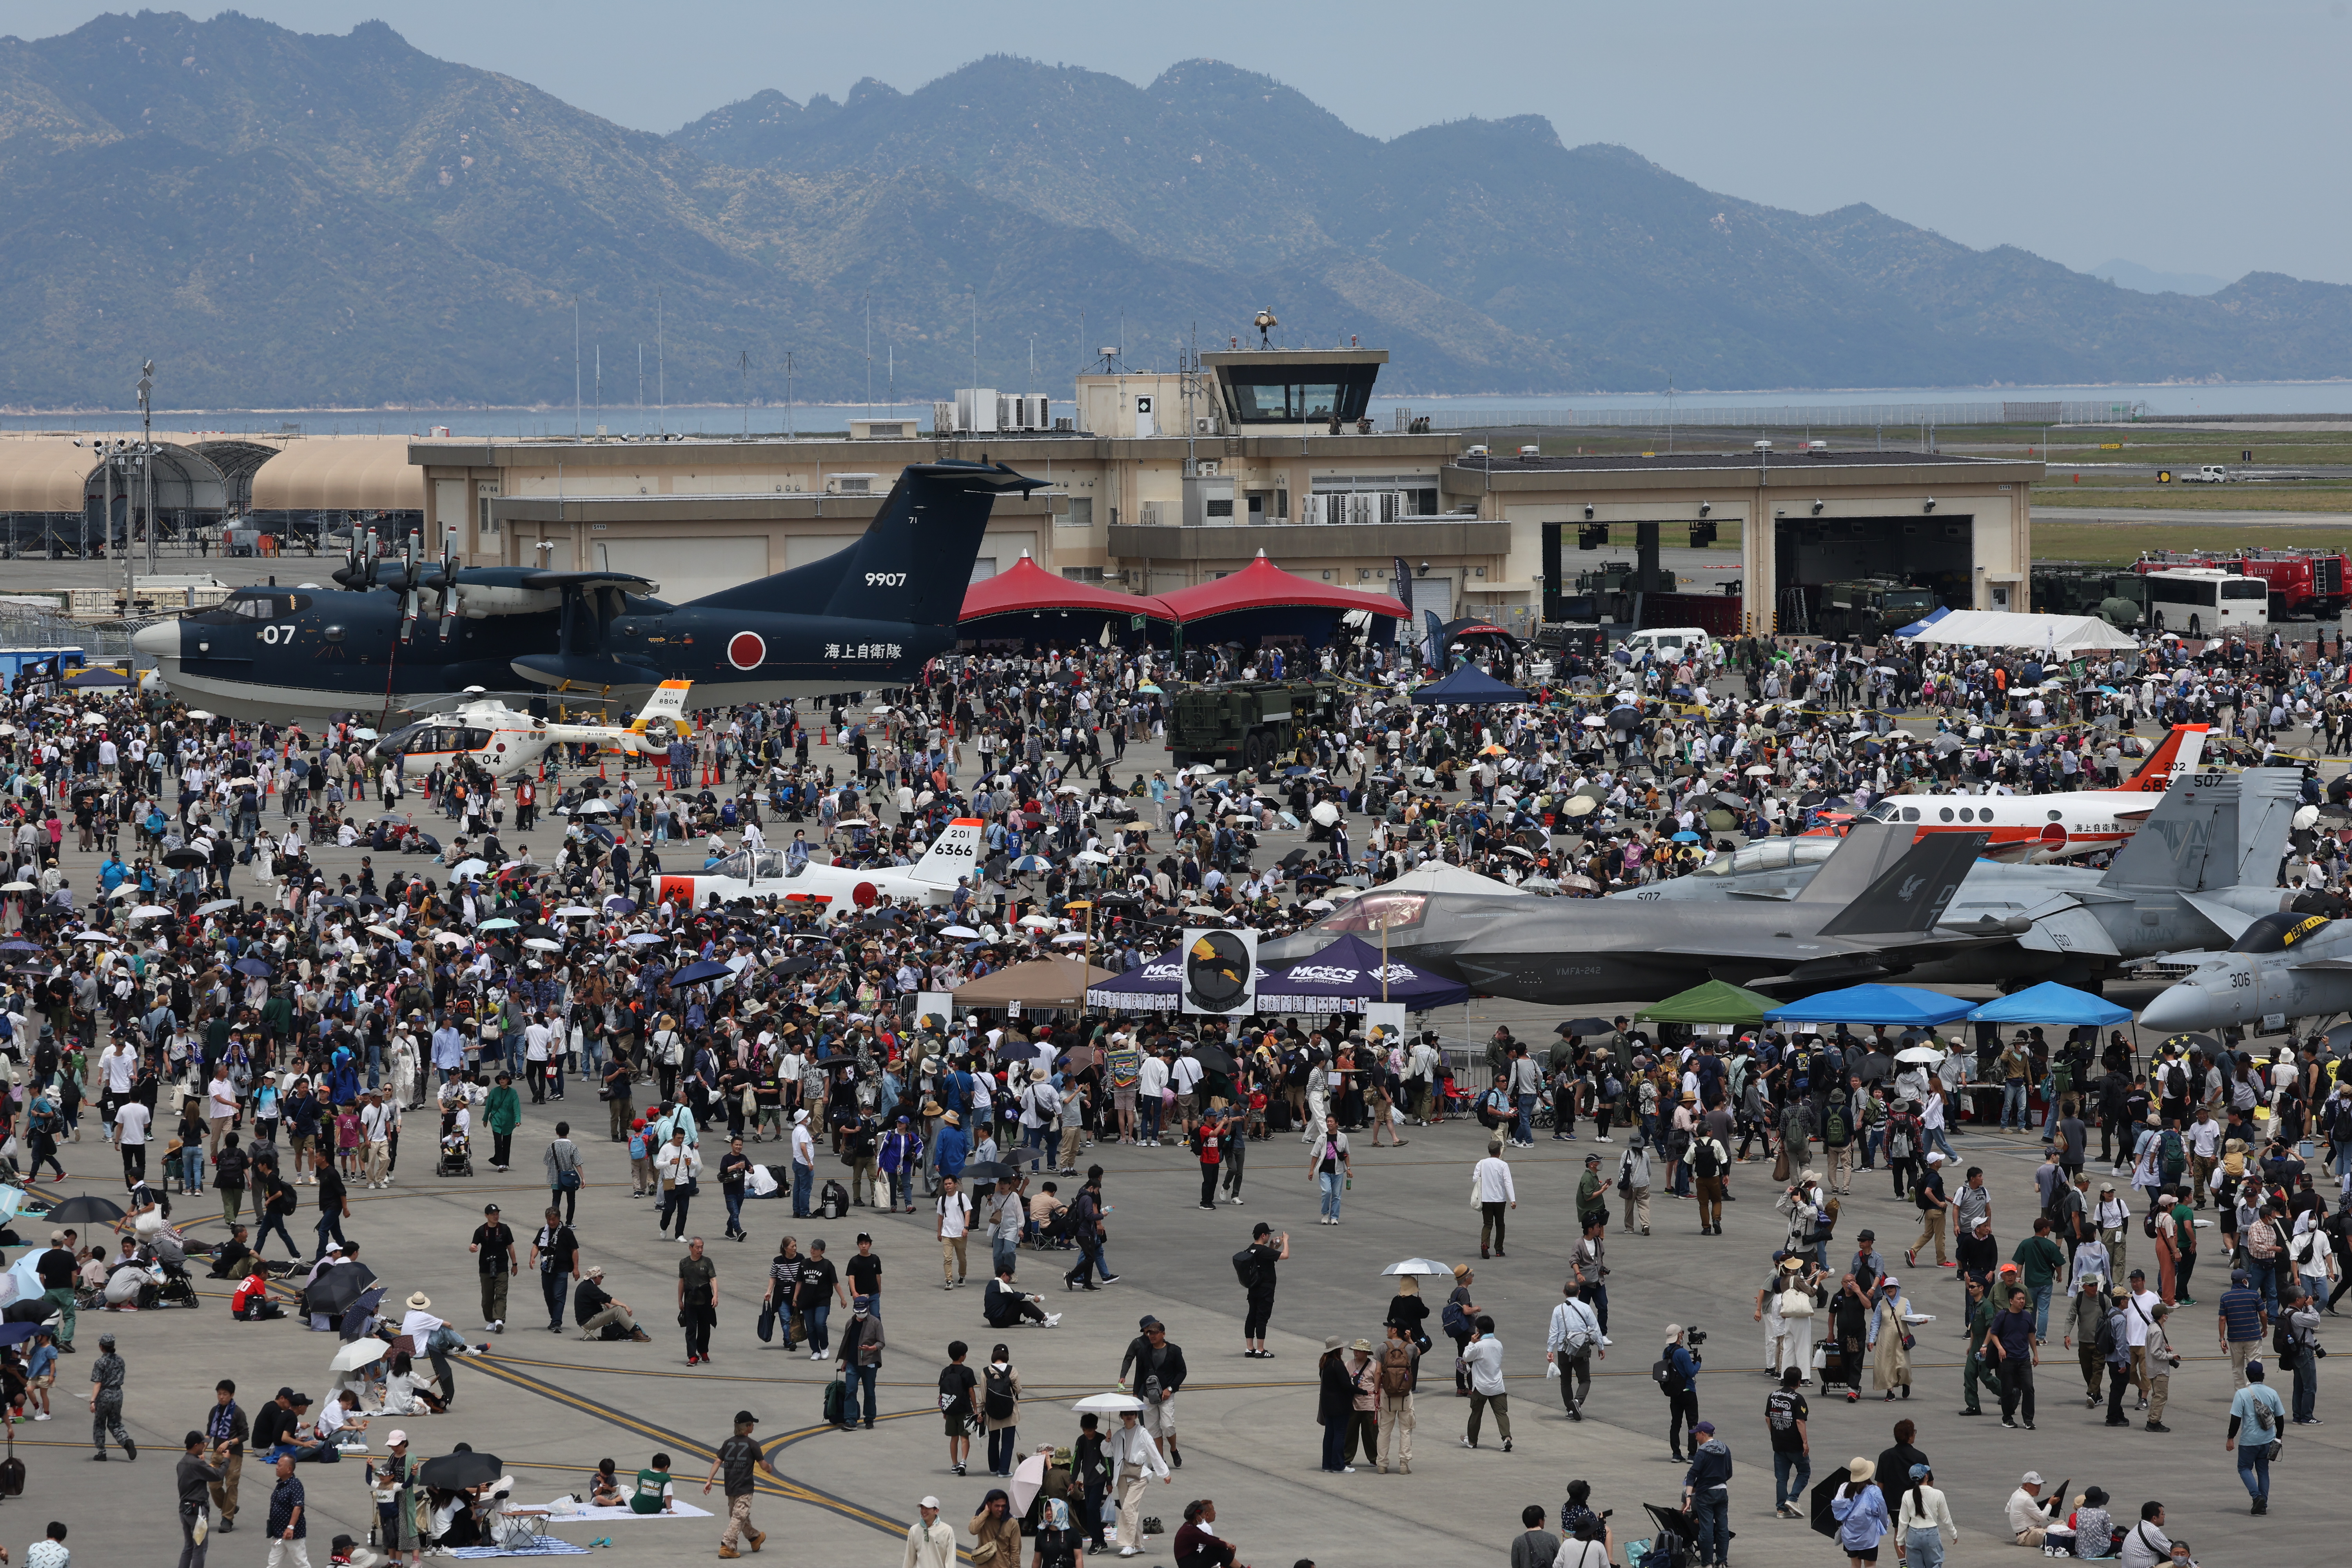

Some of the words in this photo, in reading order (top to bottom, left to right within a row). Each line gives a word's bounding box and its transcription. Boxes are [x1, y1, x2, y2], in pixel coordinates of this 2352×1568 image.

[2287, 570, 2291, 580] 1
[2303, 565, 2309, 575] 1
[865, 572, 907, 587] 9907
[263, 625, 296, 644] 07
[824, 643, 902, 659] 海上自衛隊
[2074, 662, 2082, 672] B
[1316, 689, 1323, 702] 36
[483, 755, 501, 765] 04
[2164, 762, 2186, 771] 202
[2194, 775, 2223, 787] 507
[951, 830, 970, 838] 201
[2074, 824, 2120, 833] 海上自衛隊
[1013, 839, 1019, 848] 17
[1972, 834, 1989, 846] 16
[935, 843, 973, 857] 6366
[668, 884, 684, 895] 66
[1935, 884, 1956, 905] D
[1637, 892, 1661, 900] 507
[1924, 909, 1943, 929] T
[2053, 934, 2073, 946] 507
[2135, 928, 2176, 942] NAVY
[1856, 954, 1899, 967] ARINES
[1557, 967, 1601, 975] VMFA-242
[2230, 972, 2250, 988] 306
[1199, 998, 1218, 1011] VMFA
[1224, 998, 1237, 1009] 242
[942, 1394, 957, 1411] adidas
[1771, 1398, 1791, 1410] Norton
